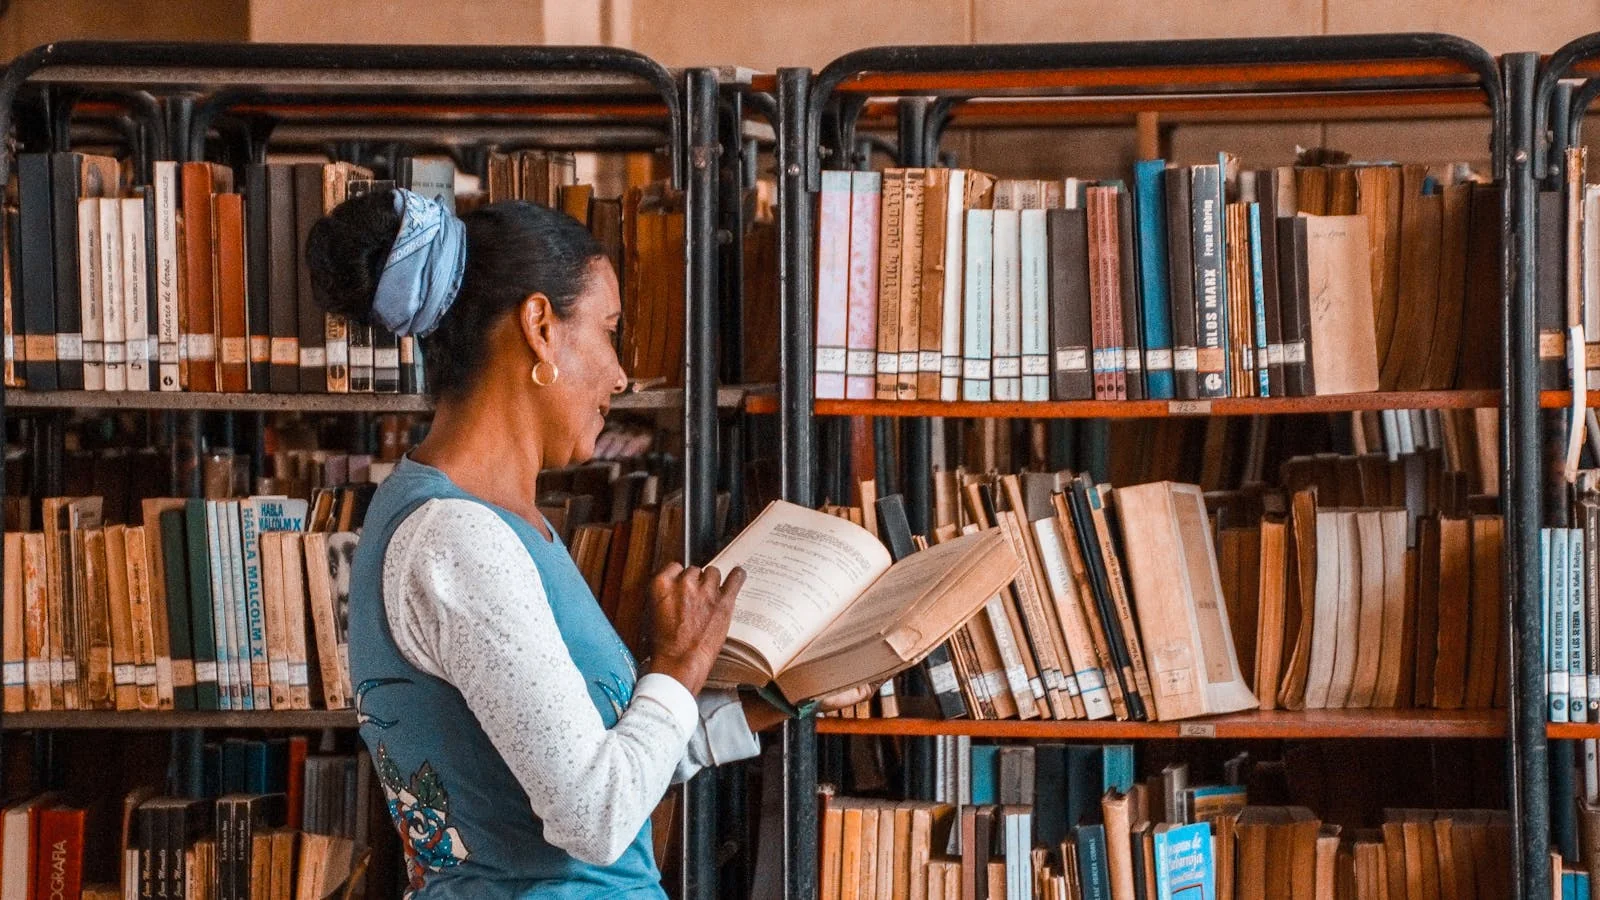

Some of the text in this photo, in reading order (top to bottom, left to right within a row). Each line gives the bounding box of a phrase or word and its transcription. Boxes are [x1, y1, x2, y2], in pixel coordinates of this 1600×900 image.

[1203, 200, 1218, 348] RLOS MARX Franz Mehring
[162, 292, 170, 302] de
[162, 305, 171, 341] stolario
[261, 504, 284, 517] HABLA
[258, 518, 301, 532] MALCOLM X
[1112, 568, 1118, 576] de
[243, 508, 263, 658] HABLA MALCOLM X
[1115, 578, 1126, 605] memoria
[1572, 611, 1580, 636] SETENTA
[1572, 638, 1580, 649] LOS
[1572, 651, 1580, 659] EN
